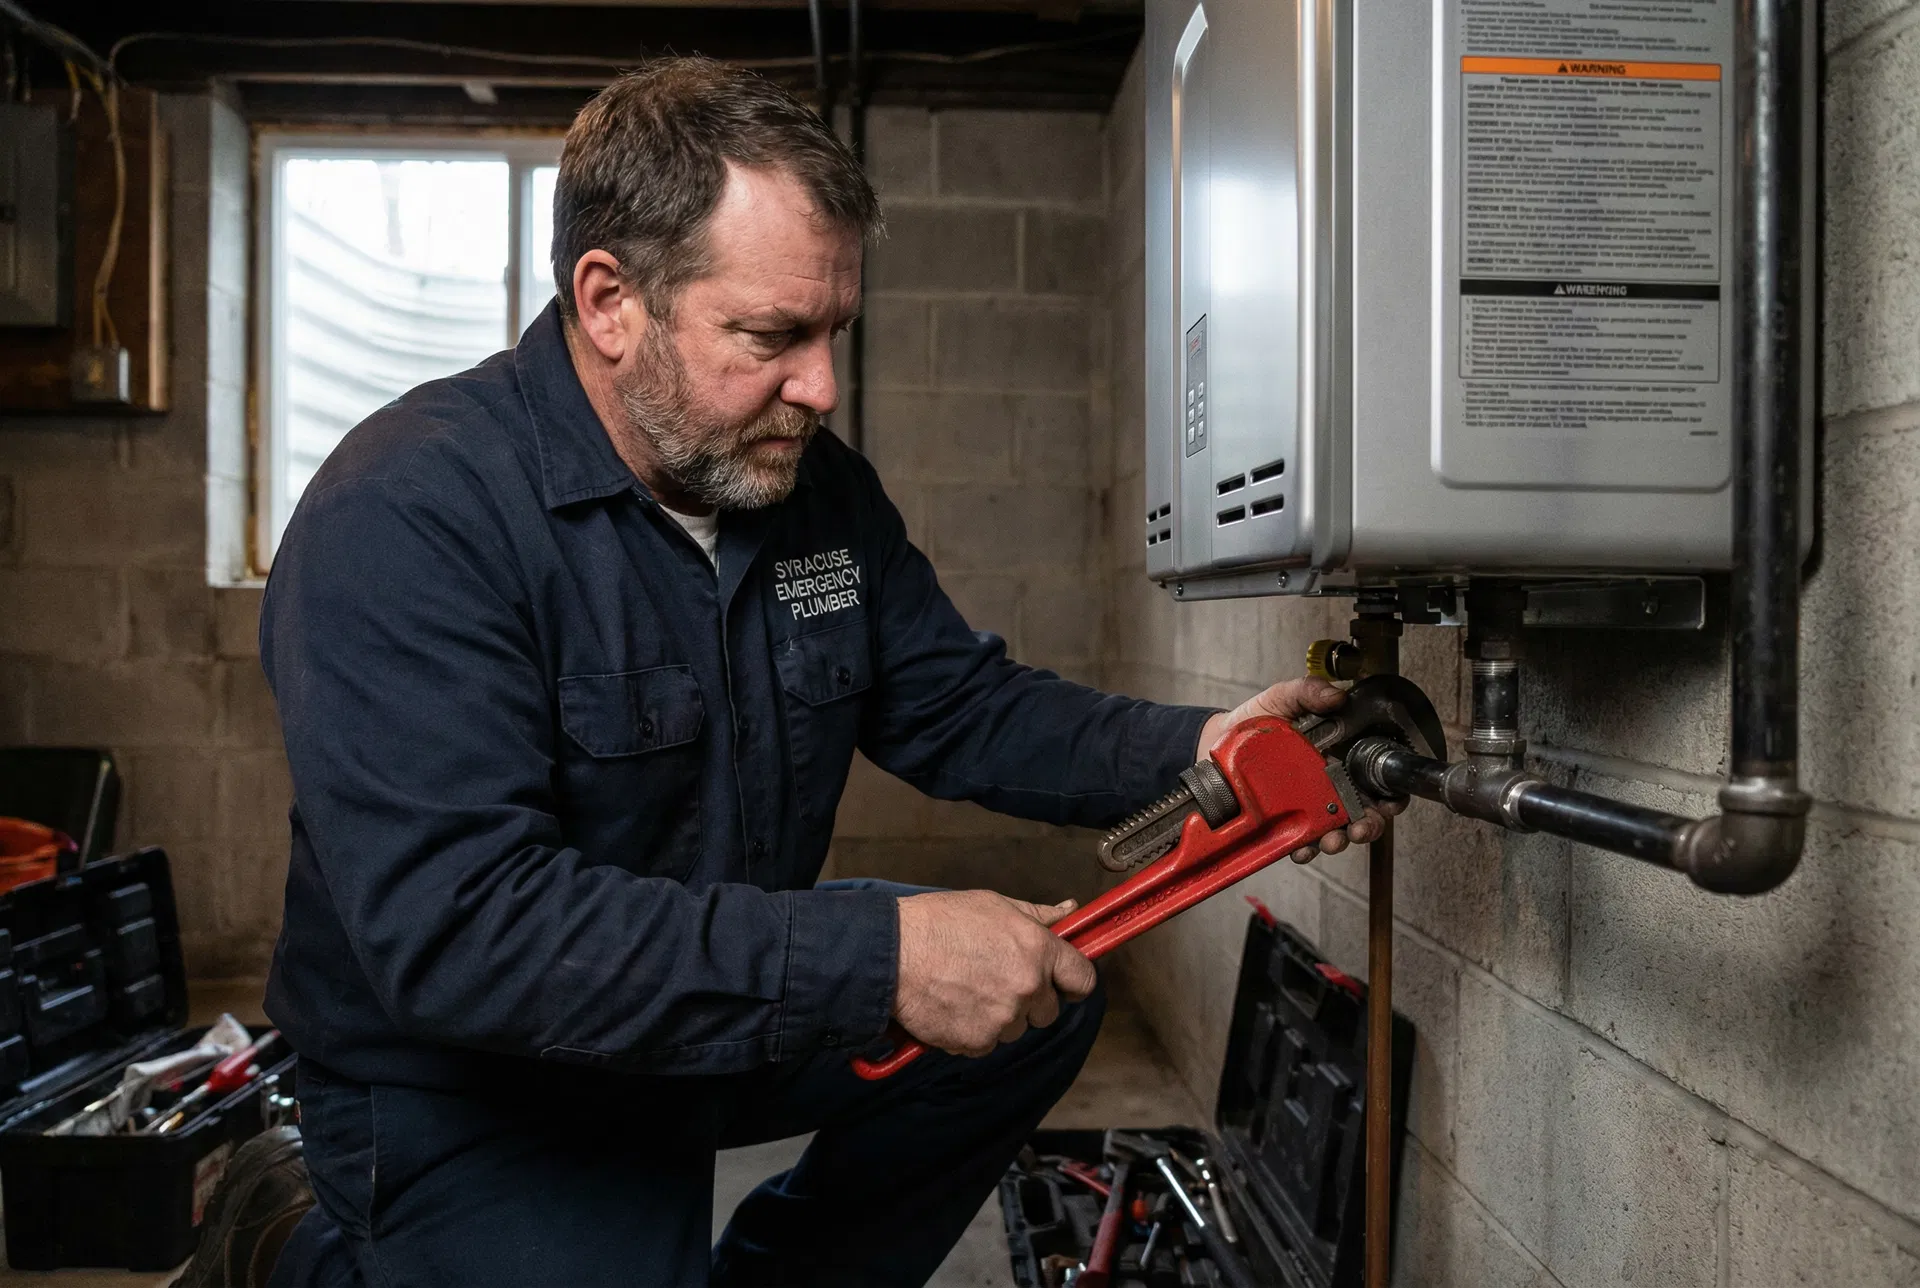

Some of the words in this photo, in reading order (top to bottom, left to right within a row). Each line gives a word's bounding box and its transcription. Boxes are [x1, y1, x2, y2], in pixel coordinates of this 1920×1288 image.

[1570, 63, 1626, 75] WARNING
[775, 549, 853, 579] SYRACUSE
[775, 566, 860, 601] EMERGENCY
[791, 589, 860, 620] PLUMBER
